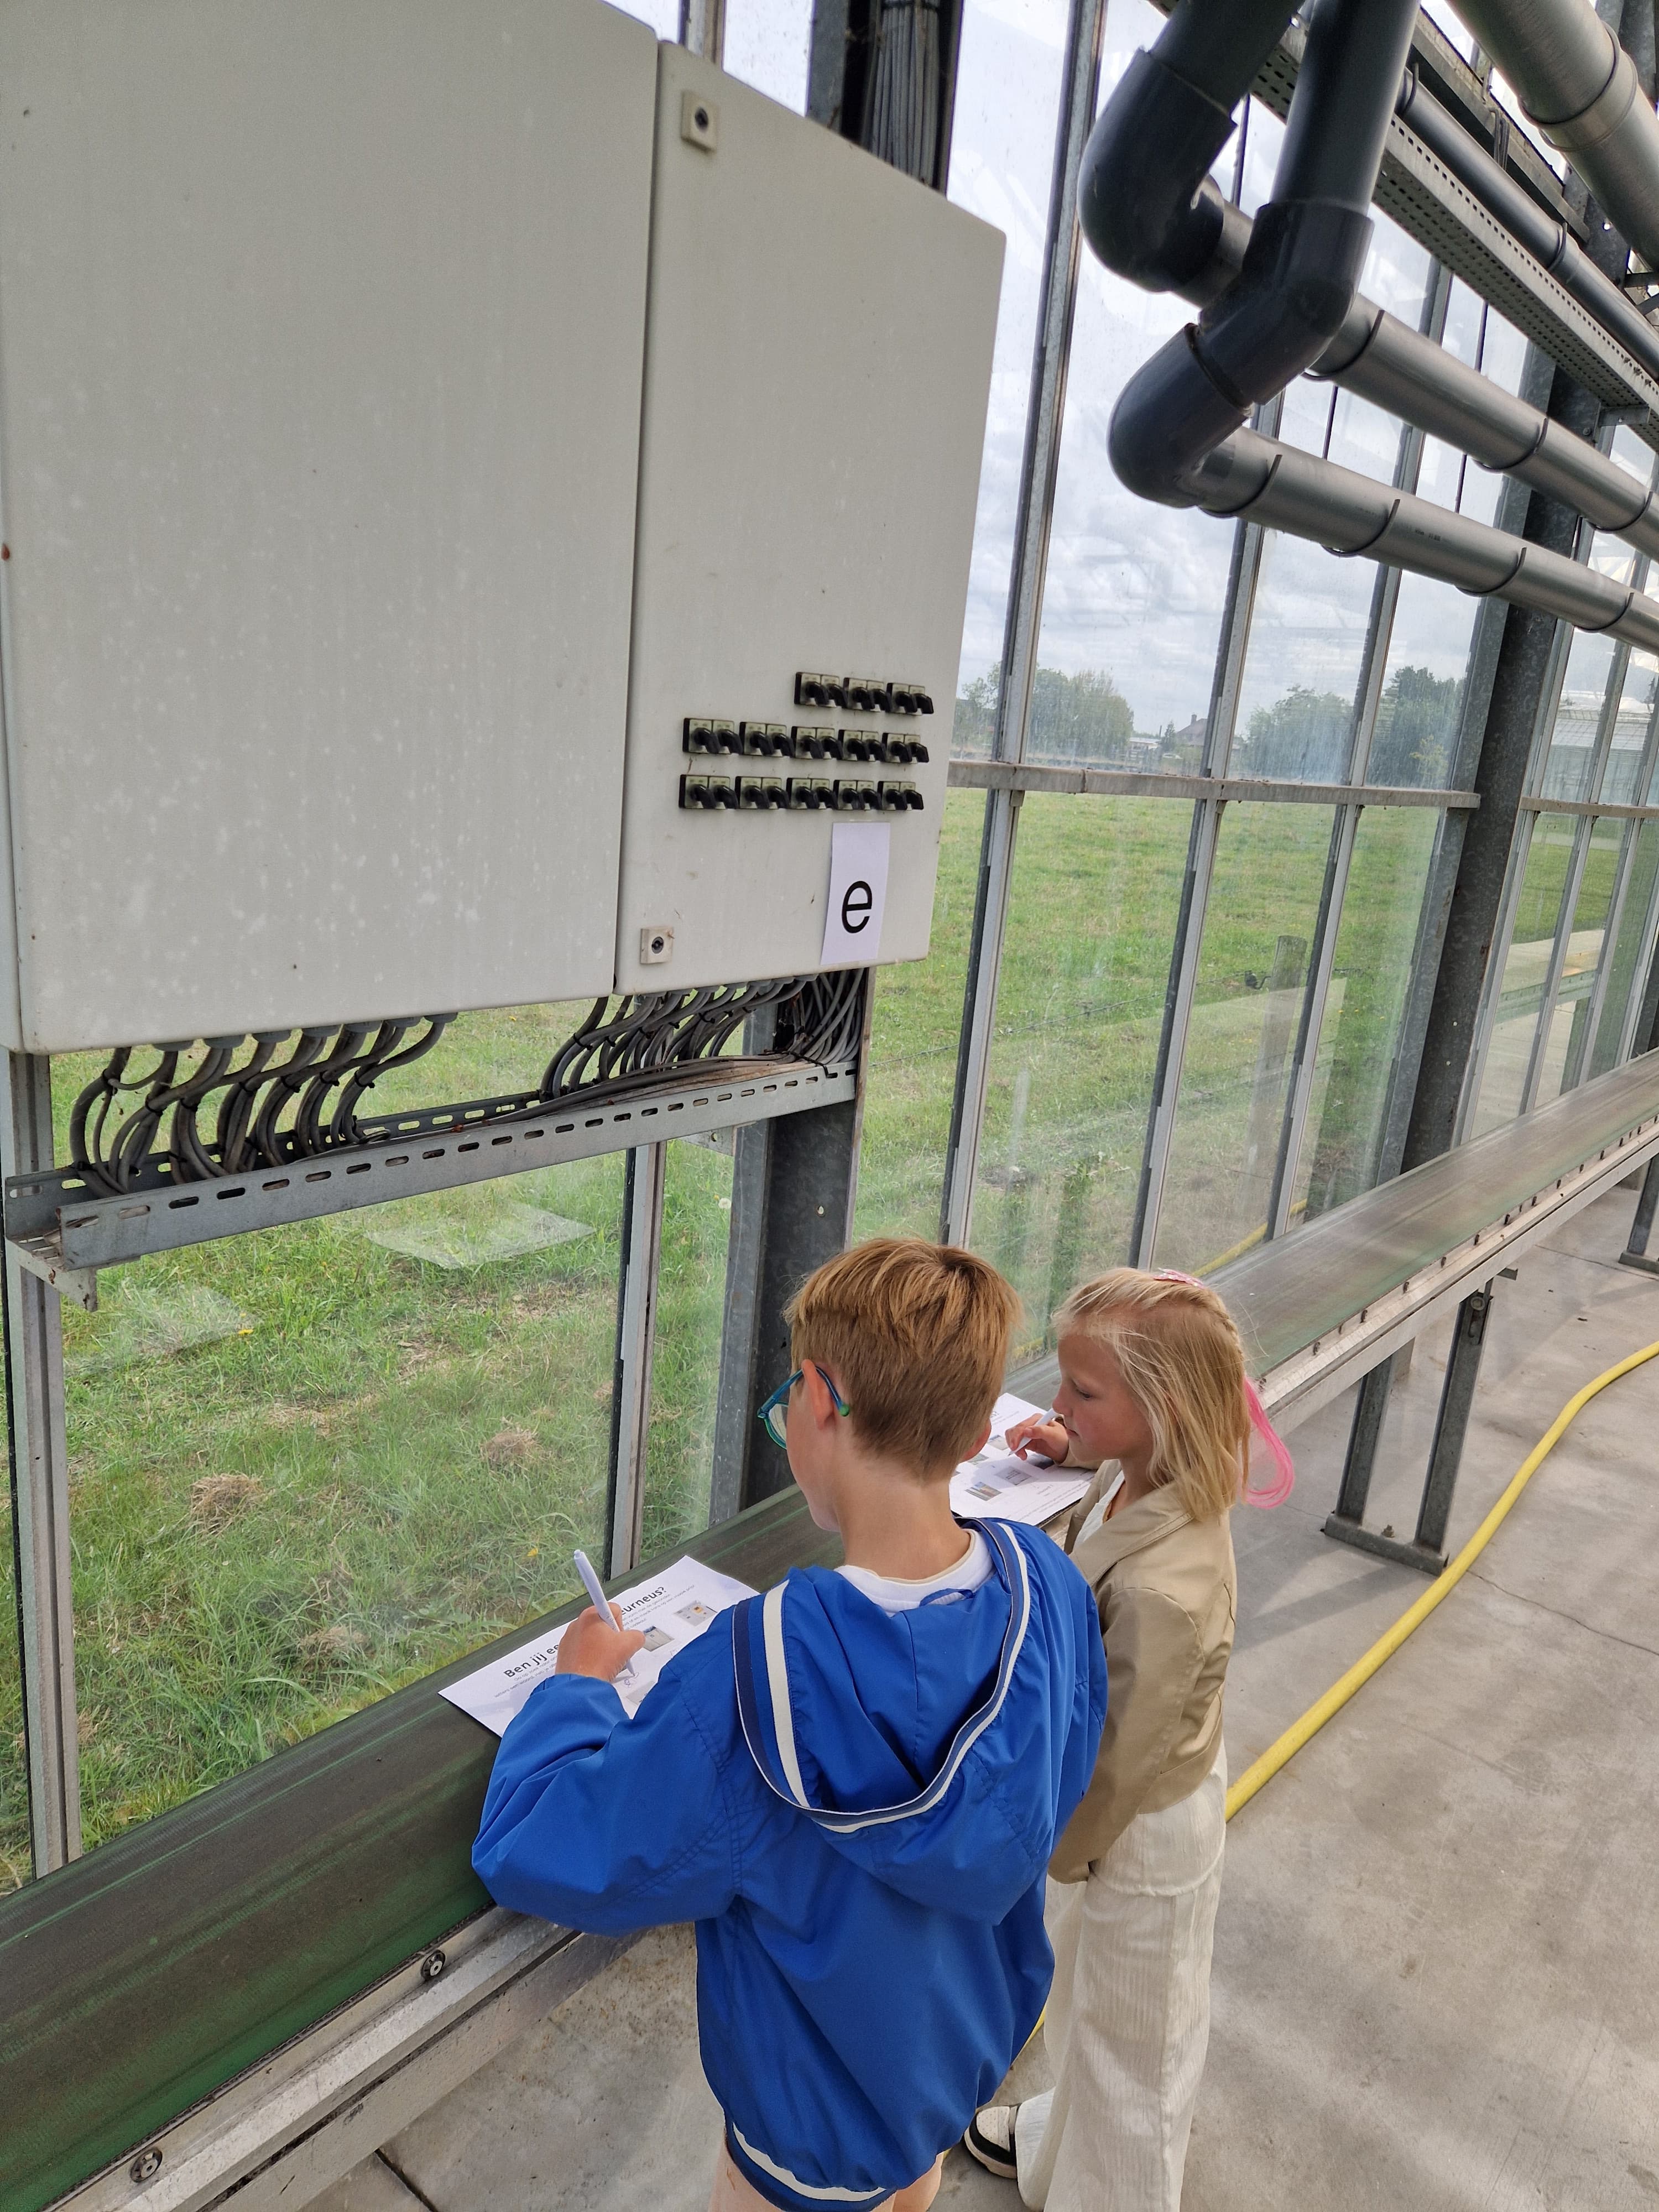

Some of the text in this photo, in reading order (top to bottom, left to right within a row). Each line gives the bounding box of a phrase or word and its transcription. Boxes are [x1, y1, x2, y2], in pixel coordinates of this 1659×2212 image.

[842, 880, 872, 933] e
[503, 1662, 531, 1677] Ben
[530, 1652, 547, 1665] jij
